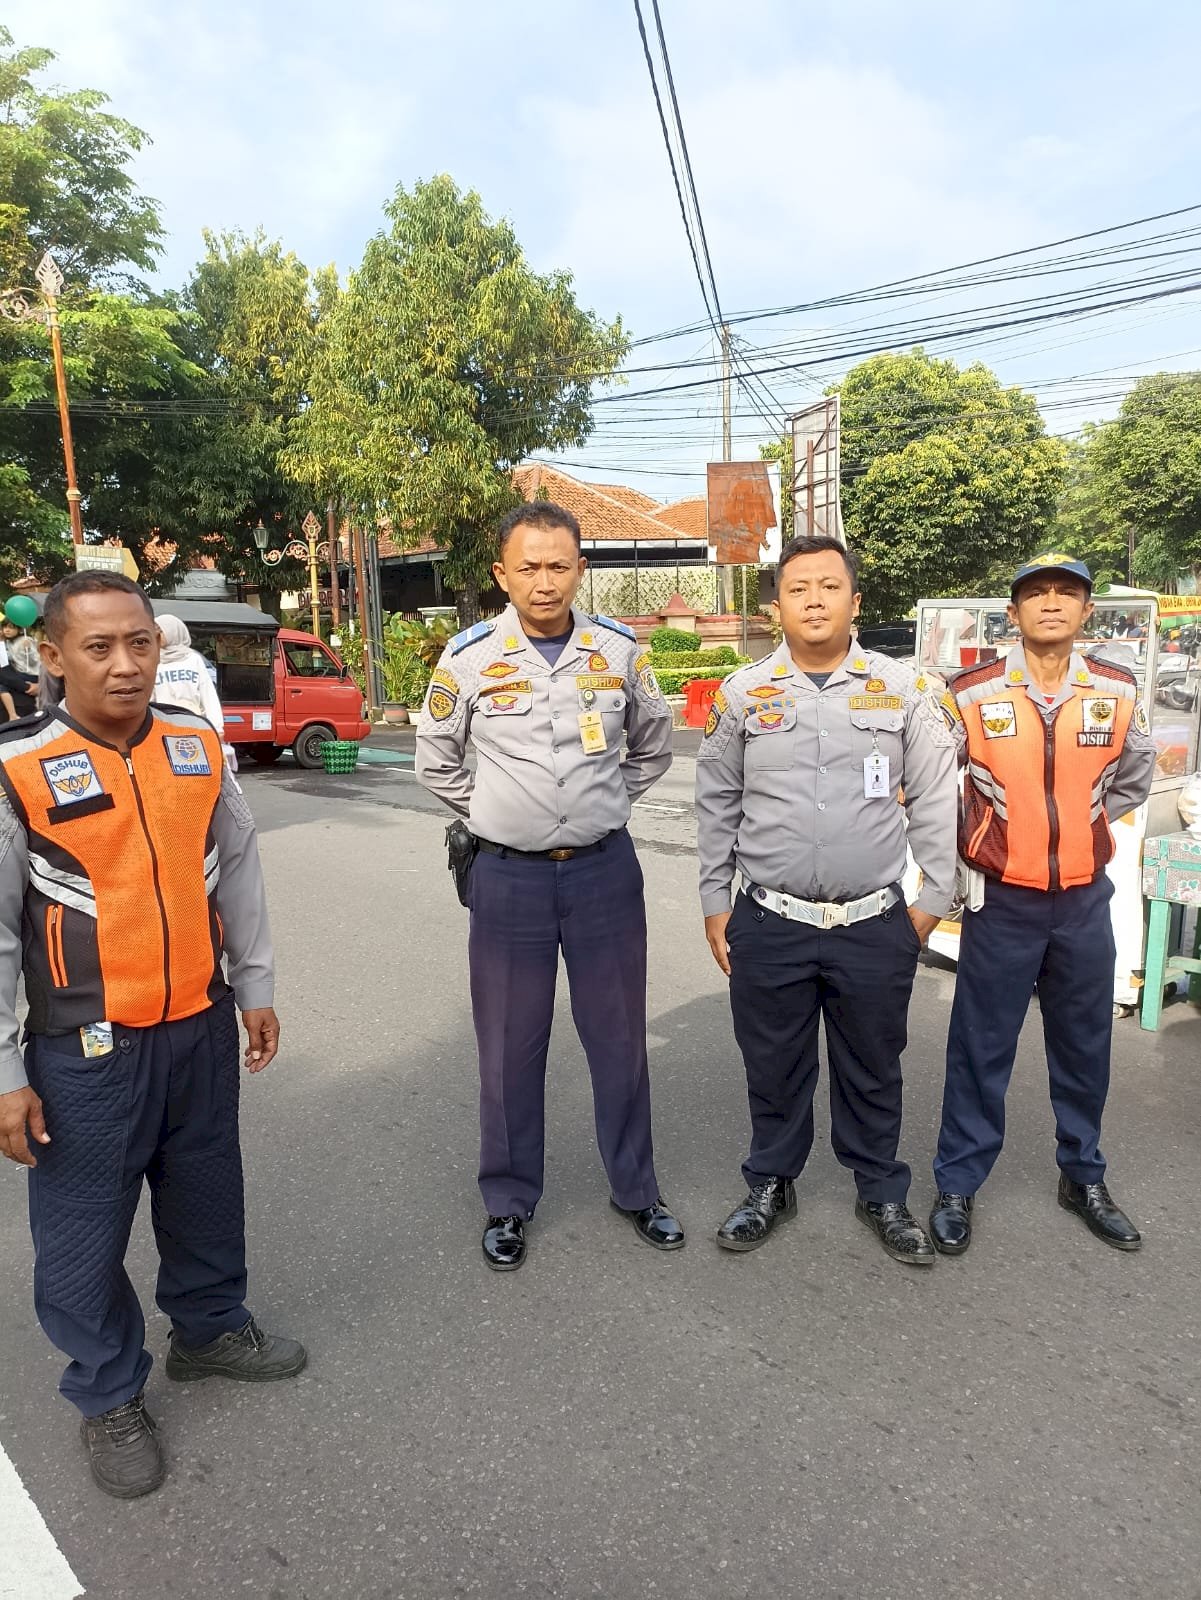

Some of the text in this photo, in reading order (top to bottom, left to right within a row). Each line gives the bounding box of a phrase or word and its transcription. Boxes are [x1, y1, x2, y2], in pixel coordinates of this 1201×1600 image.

[154, 669, 199, 685] HEESE
[579, 677, 621, 688] DISHUB
[852, 697, 899, 707] DISHUB
[49, 759, 89, 778] DISHUB
[174, 764, 209, 774] DISHUB
